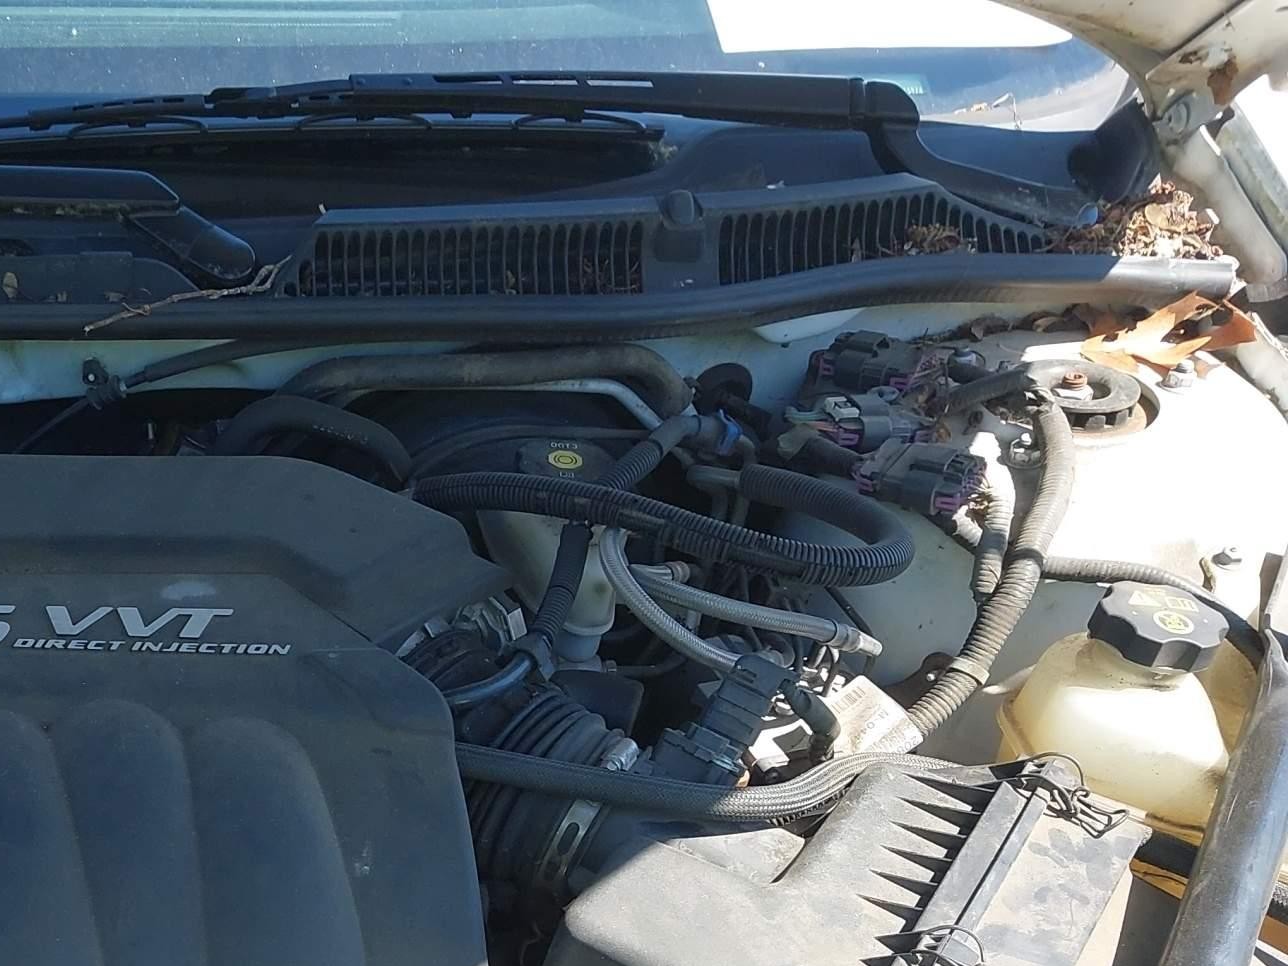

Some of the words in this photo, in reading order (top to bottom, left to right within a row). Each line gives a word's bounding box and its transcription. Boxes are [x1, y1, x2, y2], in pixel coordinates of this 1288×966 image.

[45, 605, 235, 638] VVT
[13, 638, 125, 652] DIRECT
[131, 641, 292, 656] INJECTION
